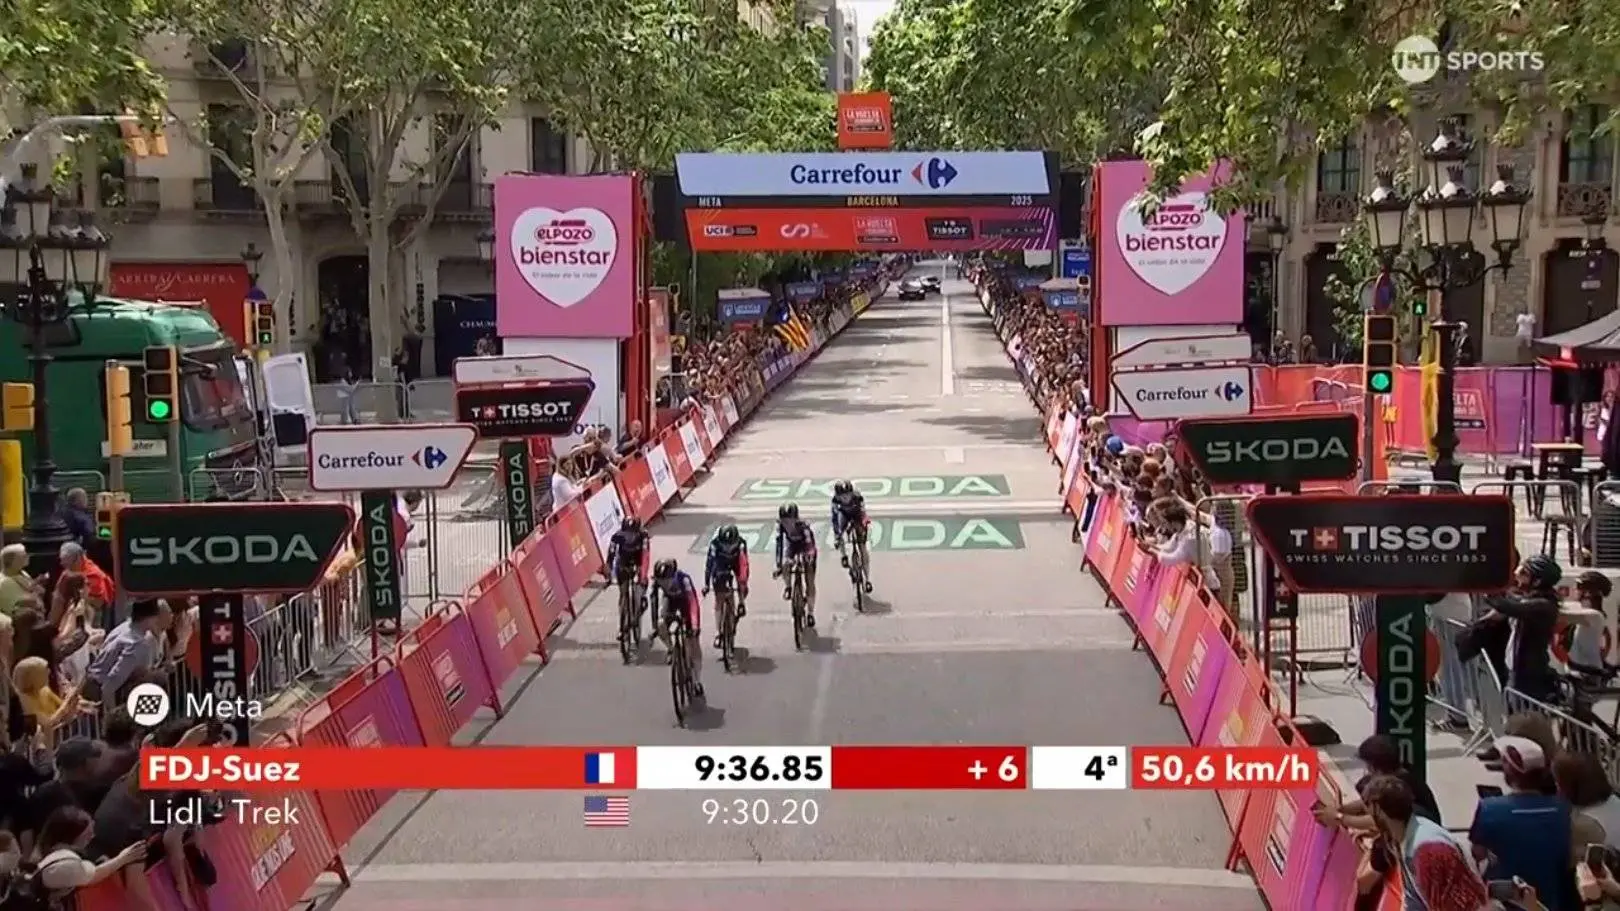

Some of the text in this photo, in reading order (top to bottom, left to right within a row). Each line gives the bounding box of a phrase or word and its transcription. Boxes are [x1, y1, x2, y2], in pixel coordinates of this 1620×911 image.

[790, 163, 902, 186] Carrefour
[699, 197, 722, 207] META
[847, 196, 899, 207] BARCELONA
[1011, 196, 1033, 206] 2025
[706, 227, 724, 235] UCI
[932, 226, 967, 235] TISSOT
[1125, 233, 1221, 252] bienstar
[519, 246, 611, 265] bienstar
[459, 320, 496, 328] CHAUM
[1135, 385, 1209, 402] Carrefour
[498, 401, 572, 418] TISSOT
[318, 451, 404, 469] Carrefour
[733, 517, 1014, 550] ODA
[1289, 525, 1487, 550] T TISSOT
[1286, 553, 1488, 564] SWISS WATCHES SINCE 1853
[212, 602, 239, 748] T TISS
